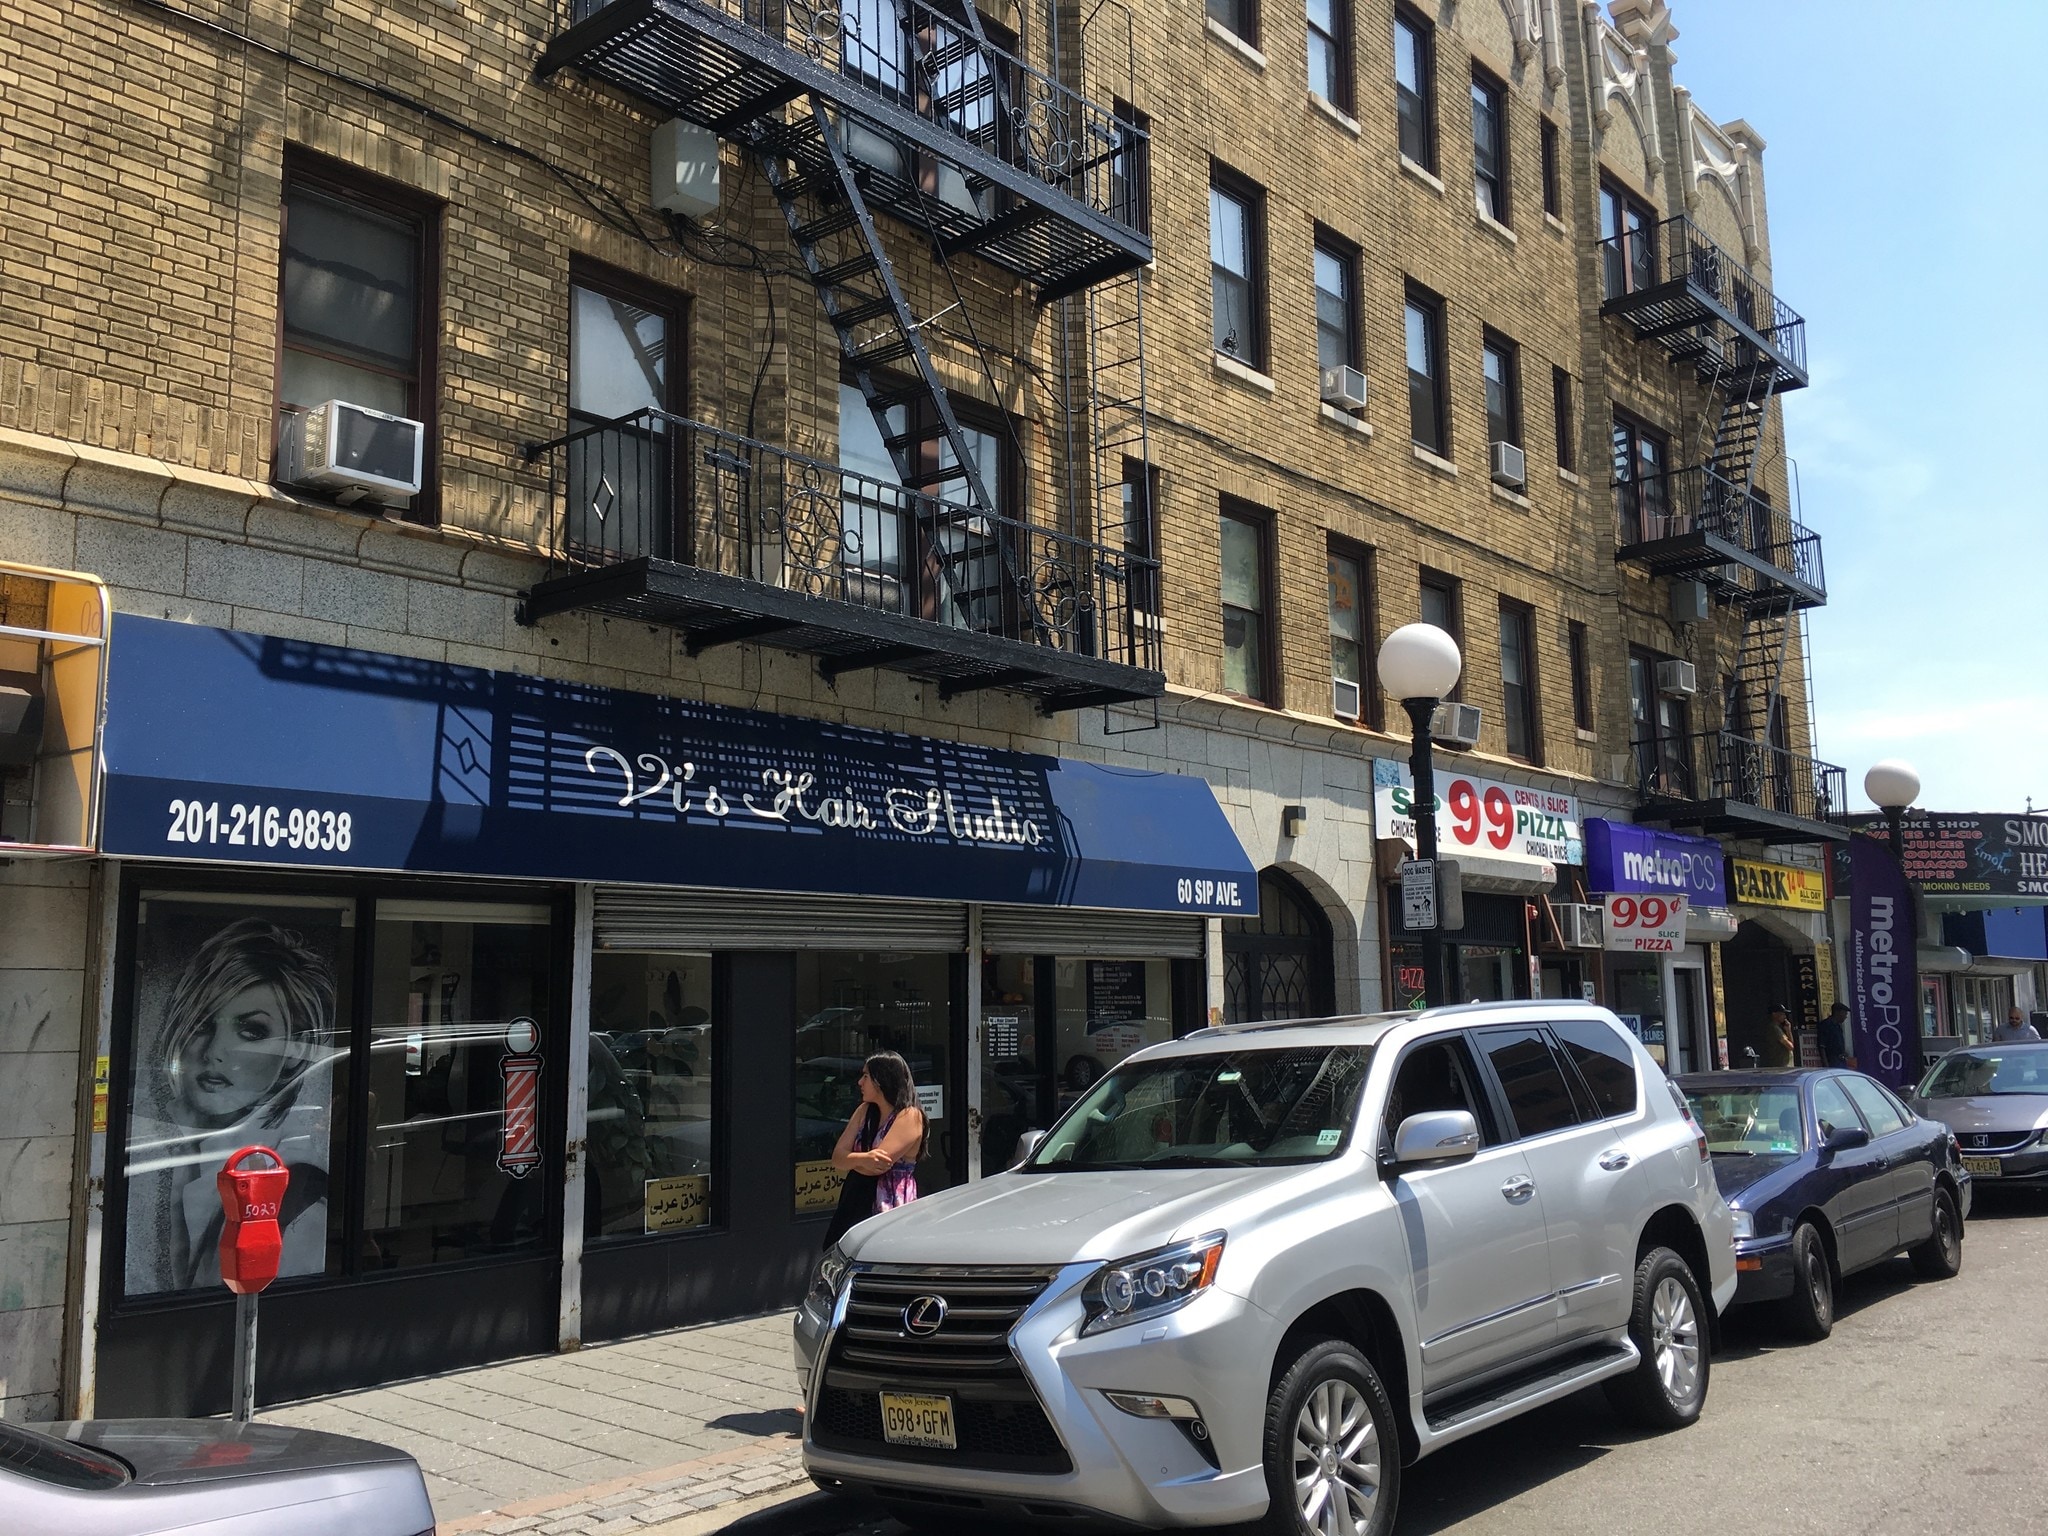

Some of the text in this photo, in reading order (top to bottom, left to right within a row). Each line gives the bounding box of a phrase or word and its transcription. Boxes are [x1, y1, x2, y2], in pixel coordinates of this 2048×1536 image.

[742, 768, 877, 830] Hair
[885, 787, 1043, 846] Studio
[1448, 779, 1514, 850] 99
[1514, 789, 1569, 814] CENTS A SLICE
[167, 799, 352, 852] 201-216-9838
[1517, 809, 1568, 840] PIZZA
[1938, 821, 1980, 829] SHOP
[1940, 830, 1983, 839] E-CIG
[1526, 840, 1549, 858] CHICKEN
[1404, 866, 1432, 876] DOG WASTE
[1623, 850, 1716, 892] metroPCS
[1735, 866, 1790, 902] PARK
[1178, 878, 1242, 906] 60 SIP AVE.
[1800, 890, 1821, 900] ALL DAY
[1962, 883, 1991, 891] NEEDS
[1634, 938, 1673, 951] PIZZA
[1799, 958, 1815, 990] PARK
[1855, 929, 1868, 1034] Authorized Dealer
[1870, 896, 1903, 1071] metroPCS
[1803, 1000, 1818, 1031] HERE
[1649, 1030, 1664, 1041] LINES
[245, 1202, 276, 1218] 5023
[899, 1396, 933, 1407] New Jersey
[888, 1407, 950, 1436] G98 GFM
